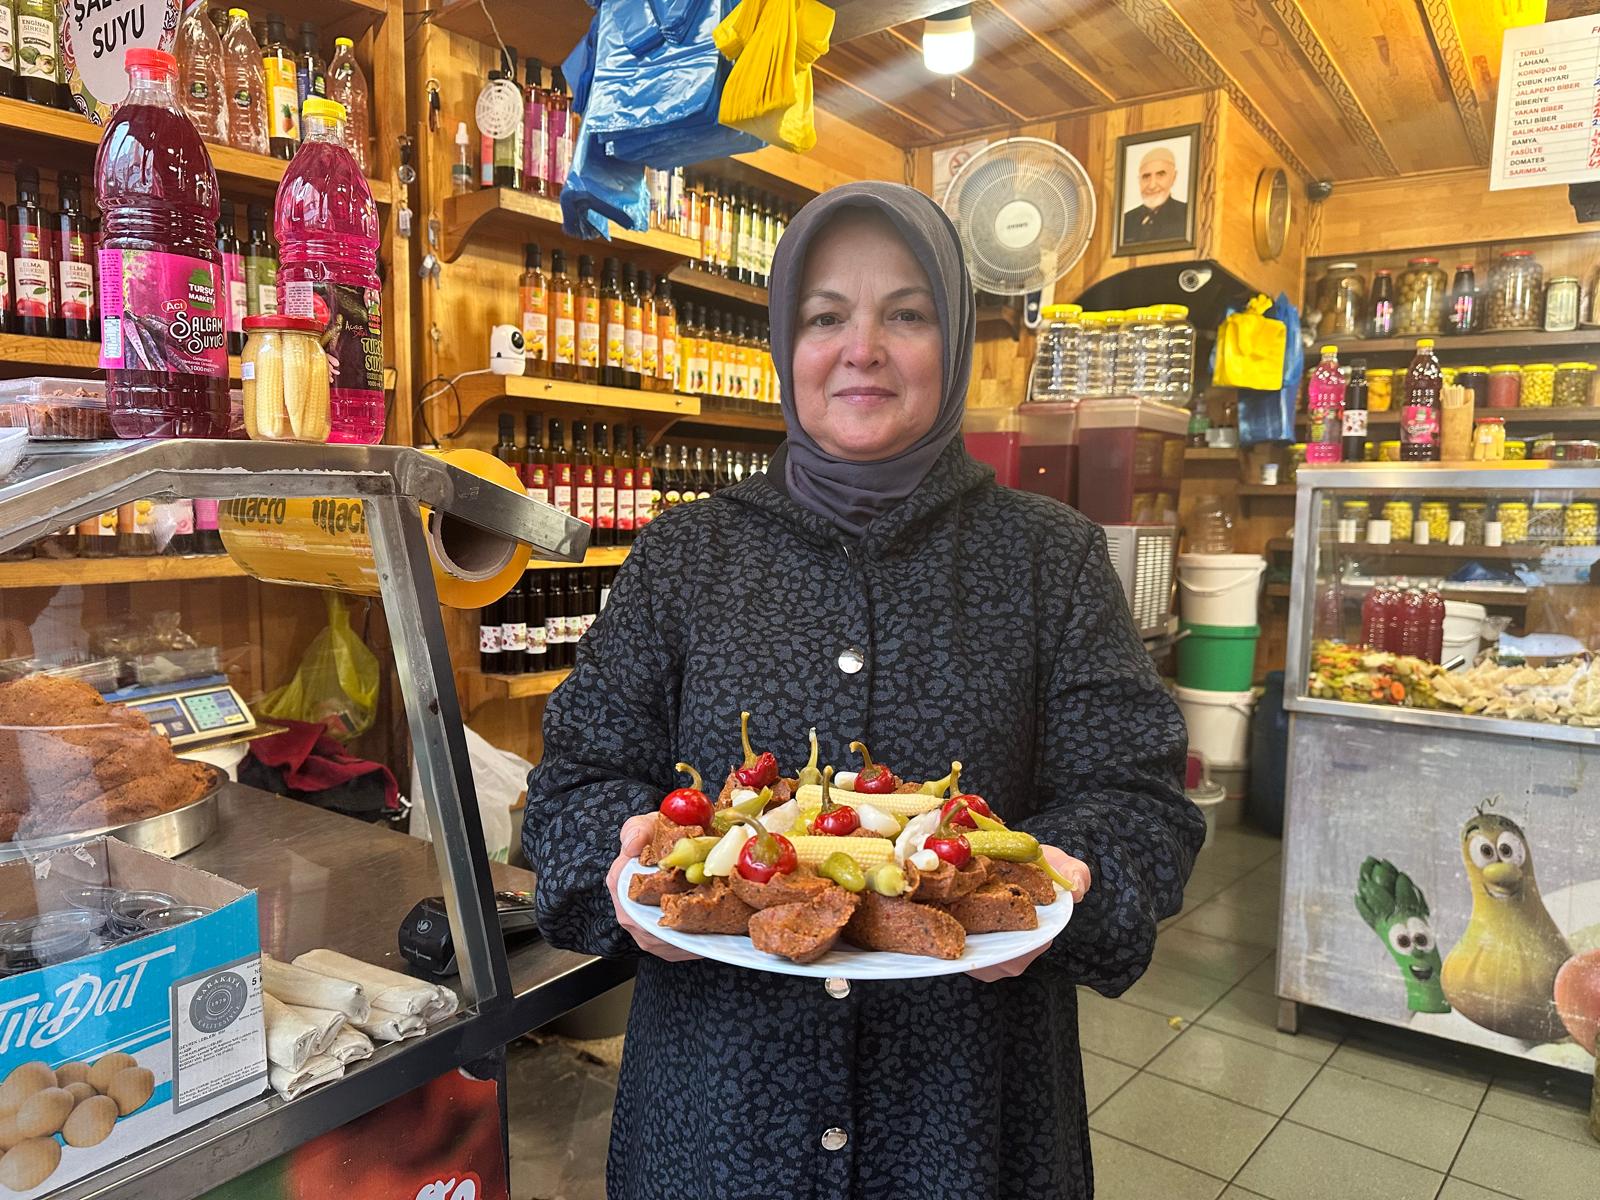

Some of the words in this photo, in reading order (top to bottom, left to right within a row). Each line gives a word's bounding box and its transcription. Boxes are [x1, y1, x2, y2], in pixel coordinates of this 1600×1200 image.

[92, 4, 145, 59] SUYU
[1520, 48, 1544, 57] TÜRLÜ
[1518, 58, 1549, 67] LAHANA
[1518, 66, 1557, 77] KORNİŞON
[1516, 78, 1543, 88] ÇUBUK
[1516, 86, 1555, 96] JALAPENO
[1557, 82, 1580, 91] BİBER
[1515, 96, 1549, 106] BİBERİYE
[1514, 108, 1539, 116] YAKAN
[1540, 104, 1564, 113] BİBER
[1514, 118, 1533, 126] TATLI
[1534, 115, 1557, 124] BİBER
[1560, 121, 1584, 130] BİBER
[1511, 137, 1537, 146] BAMYA
[1510, 157, 1545, 166] DOMATES
[1509, 167, 1547, 176] SARIMSAK
[188, 292, 215, 305] MARKET
[187, 331, 224, 354] SUYU
